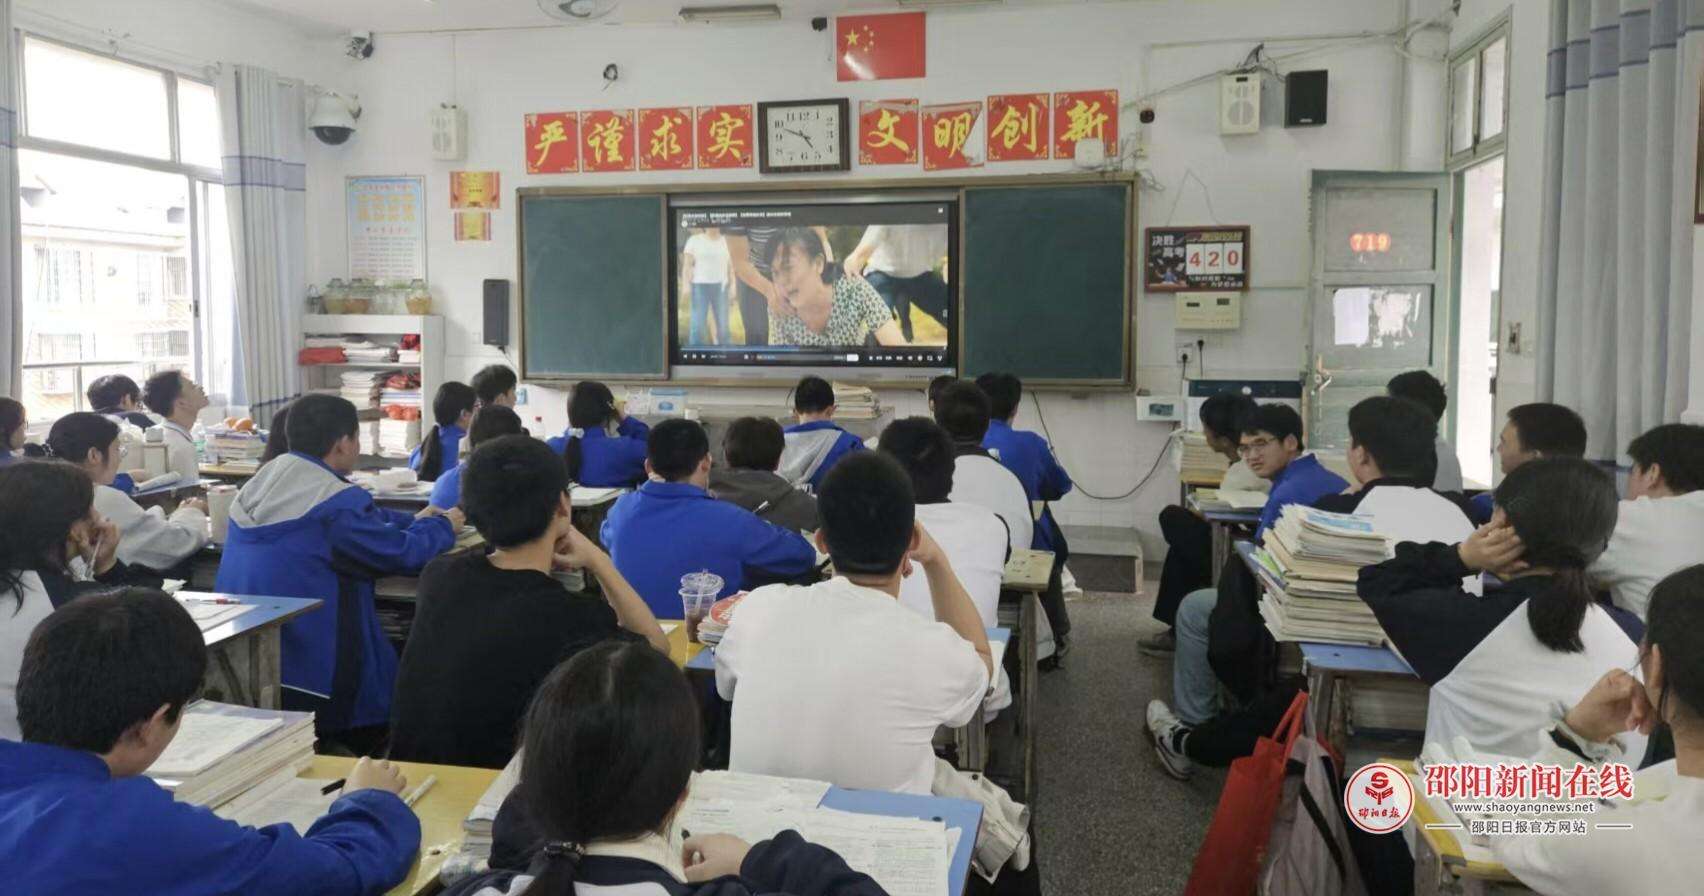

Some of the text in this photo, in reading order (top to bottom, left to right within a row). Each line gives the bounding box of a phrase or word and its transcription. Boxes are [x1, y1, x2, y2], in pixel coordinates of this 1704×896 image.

[534, 112, 745, 167] 严谨求实
[866, 99, 1109, 159] 文明创新
[1189, 250, 1239, 267] 420
[1351, 232, 1389, 252] 719
